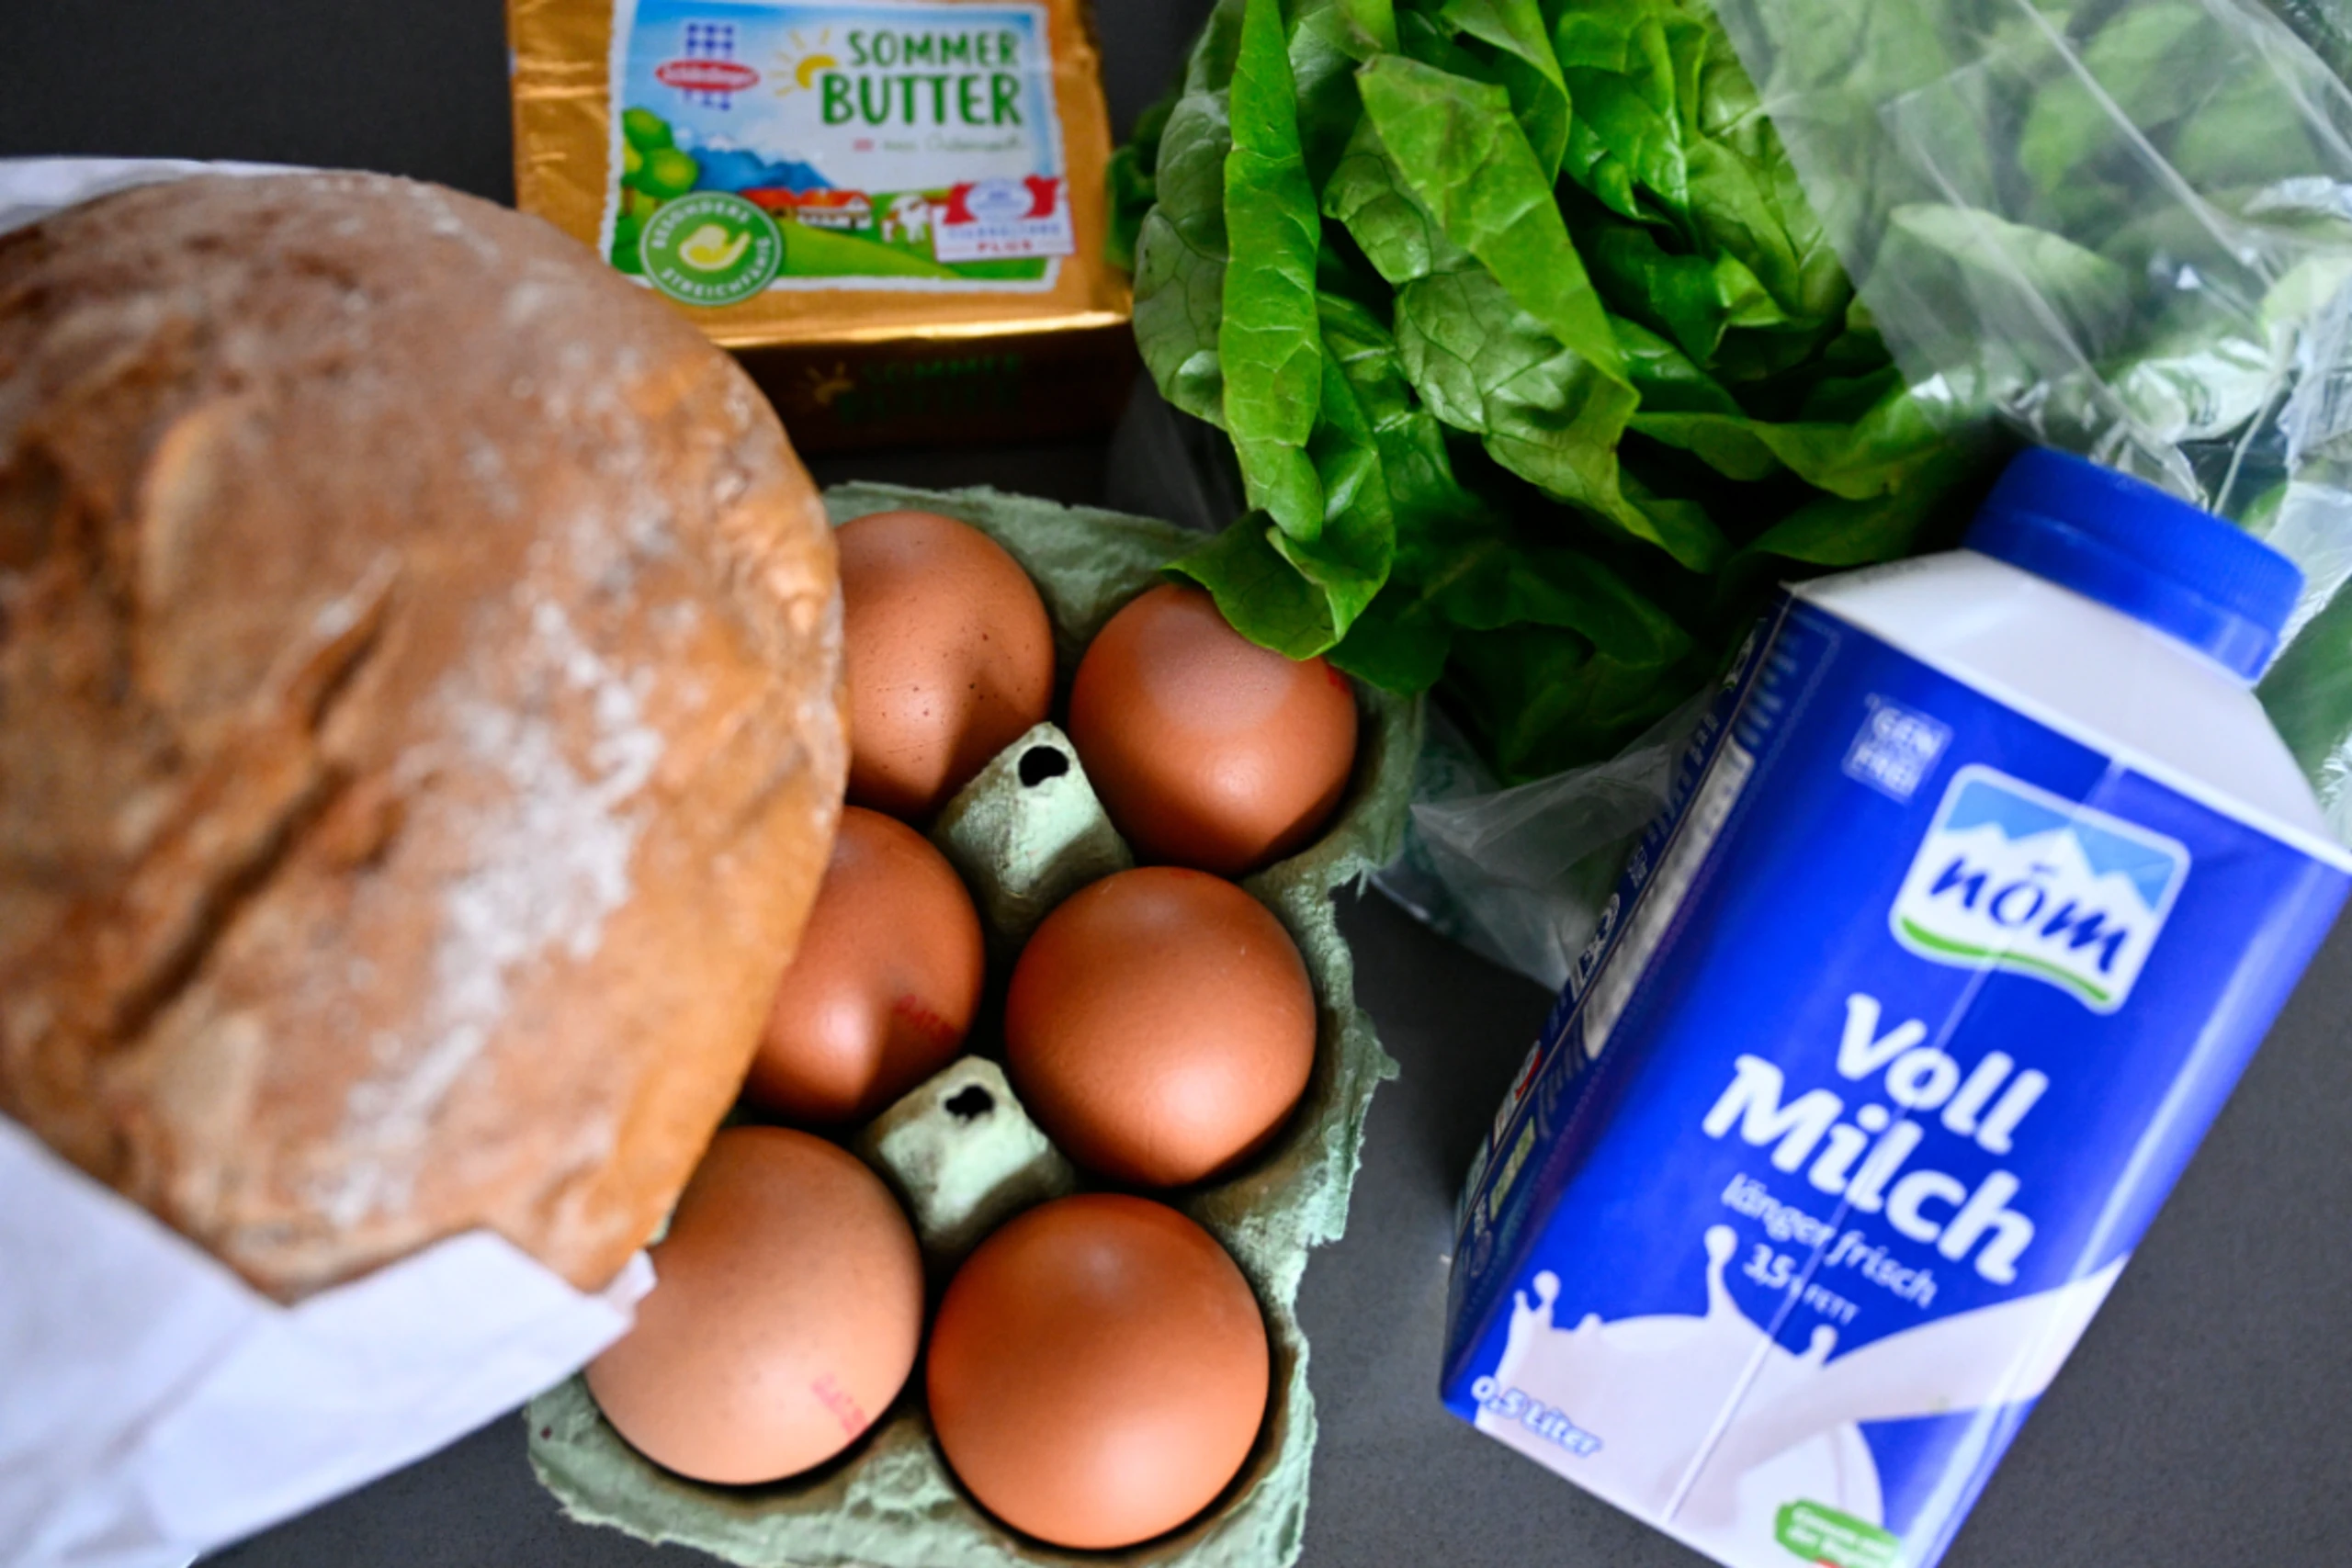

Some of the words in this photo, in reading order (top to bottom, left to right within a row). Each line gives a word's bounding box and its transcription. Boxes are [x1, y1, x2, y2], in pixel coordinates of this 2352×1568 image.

[820, 72, 1023, 126] BUTTER
[847, 29, 1019, 67] SOMMER
[1837, 992, 2049, 1155] Voll
[1702, 1054, 2035, 1284] Milch
[1721, 1171, 1836, 1248] länger
[1824, 1228, 1939, 1310] frisch
[1471, 1374, 1530, 1420] 0,5
[1521, 1398, 1603, 1459] Liter
